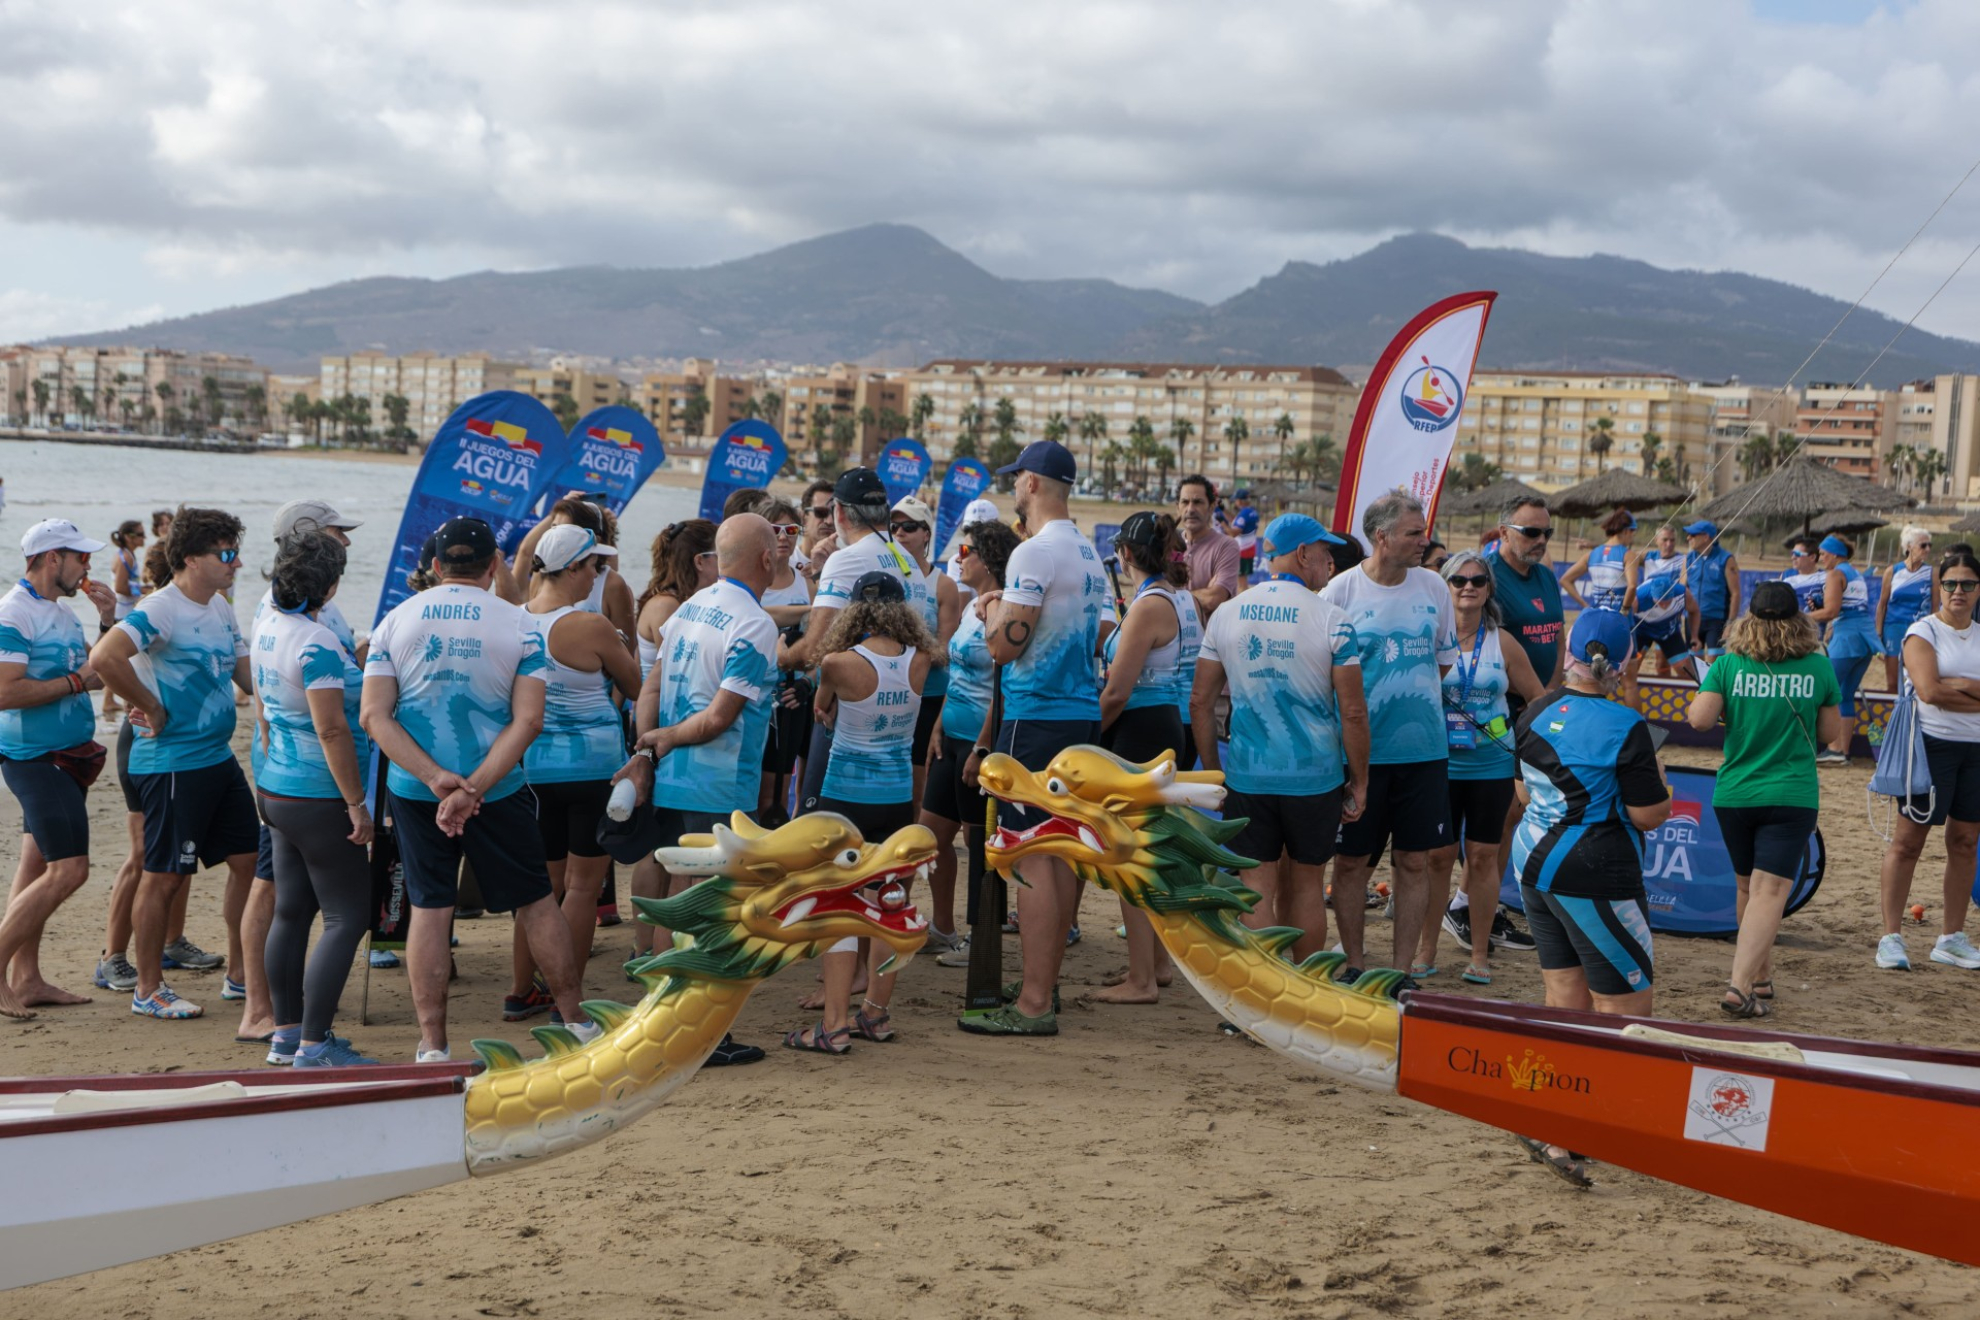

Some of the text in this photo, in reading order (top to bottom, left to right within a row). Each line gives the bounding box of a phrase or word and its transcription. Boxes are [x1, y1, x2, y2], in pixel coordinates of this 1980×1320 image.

[1414, 420, 1437, 433] RFEP
[467, 441, 513, 461] JUEGOS
[515, 454, 536, 469] DEL
[452, 450, 529, 491] AGUA
[578, 450, 635, 479] AGUA
[725, 453, 767, 474] AGUA
[888, 462, 919, 477] AGUA
[1426, 458, 1439, 496] Deportes
[421, 602, 481, 621] ANDRÉS
[1239, 604, 1299, 624] MSEOANE
[1523, 621, 1562, 635] MARATHO
[448, 636, 482, 649] Sevilla
[1266, 638, 1294, 650] Sevilla
[1402, 637, 1429, 648] Sevilla
[1541, 633, 1555, 644] BET
[1732, 670, 1815, 698] ÁRBITRO
[877, 690, 910, 706] REME
[1468, 695, 1490, 706] ragón
[1470, 688, 1491, 698] evilla
[1664, 826, 1698, 844] DEL
[1647, 894, 1677, 906] ELILLA
